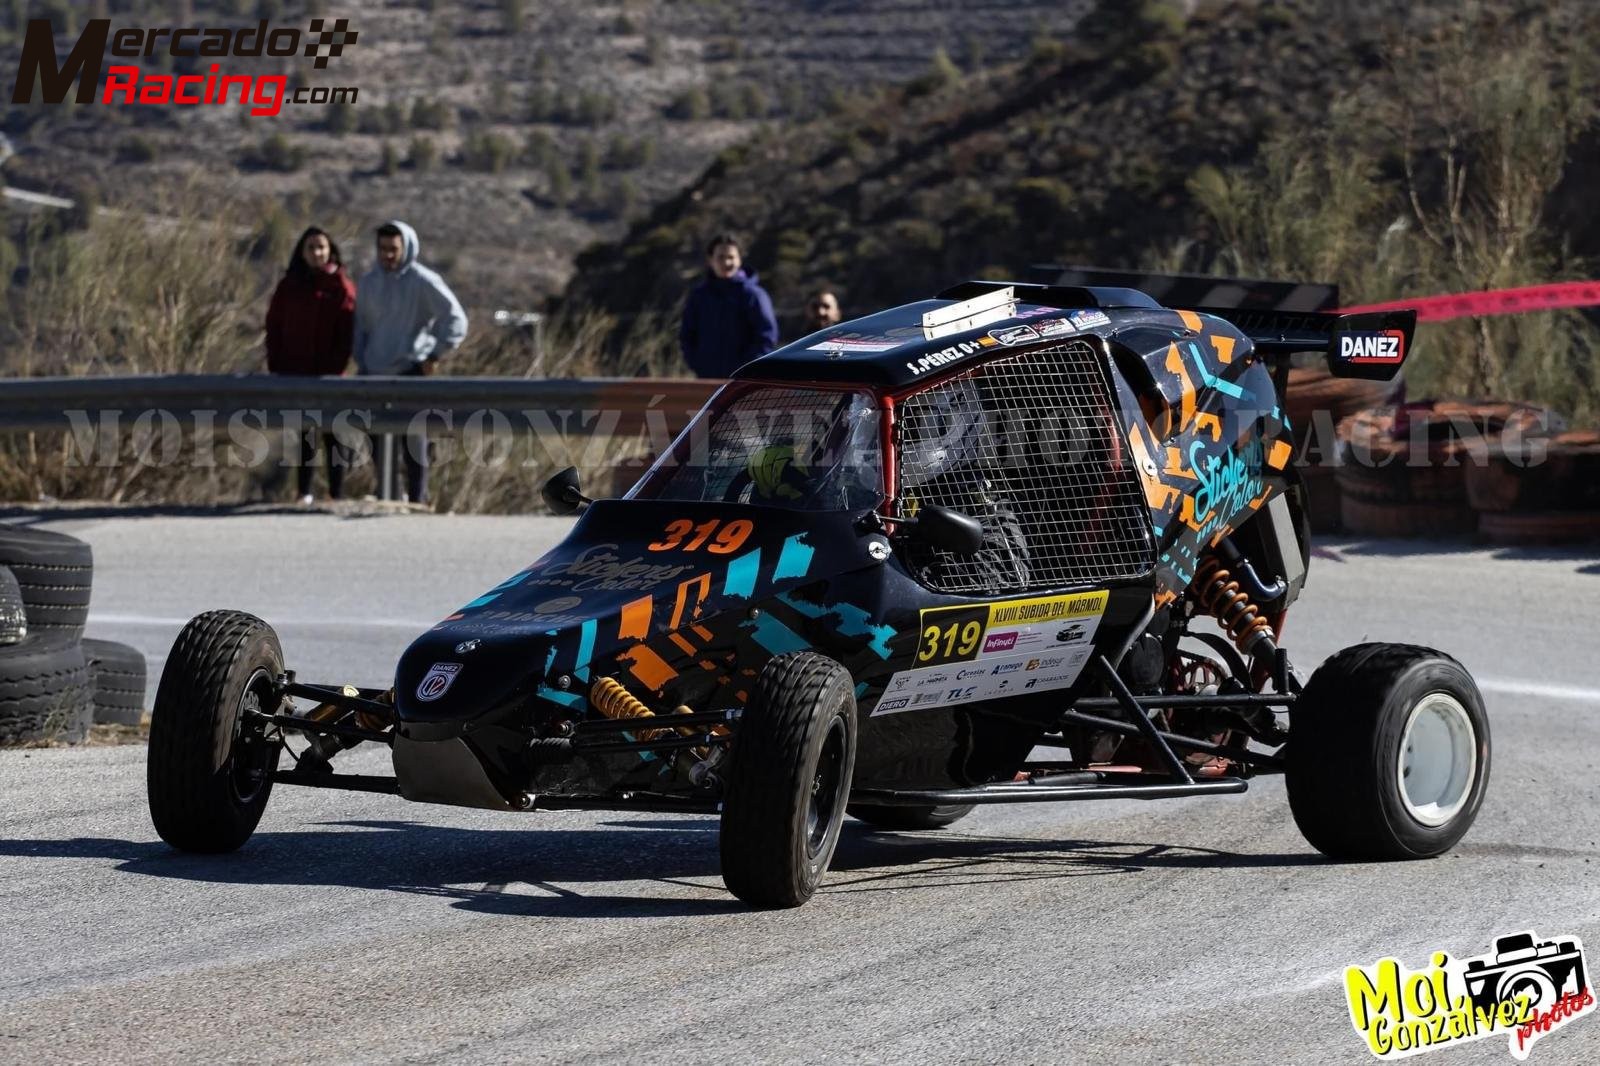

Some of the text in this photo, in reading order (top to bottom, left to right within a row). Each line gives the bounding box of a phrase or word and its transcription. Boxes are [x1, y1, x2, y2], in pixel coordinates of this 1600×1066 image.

[1341, 336, 1399, 357] DANEZ
[648, 519, 754, 554] 319
[994, 596, 1103, 623] XLVIII SUBIDA DEL MÁRMOL
[918, 620, 981, 662] 319
[433, 664, 458, 672] DANEZ
[879, 699, 907, 711] DIERO
